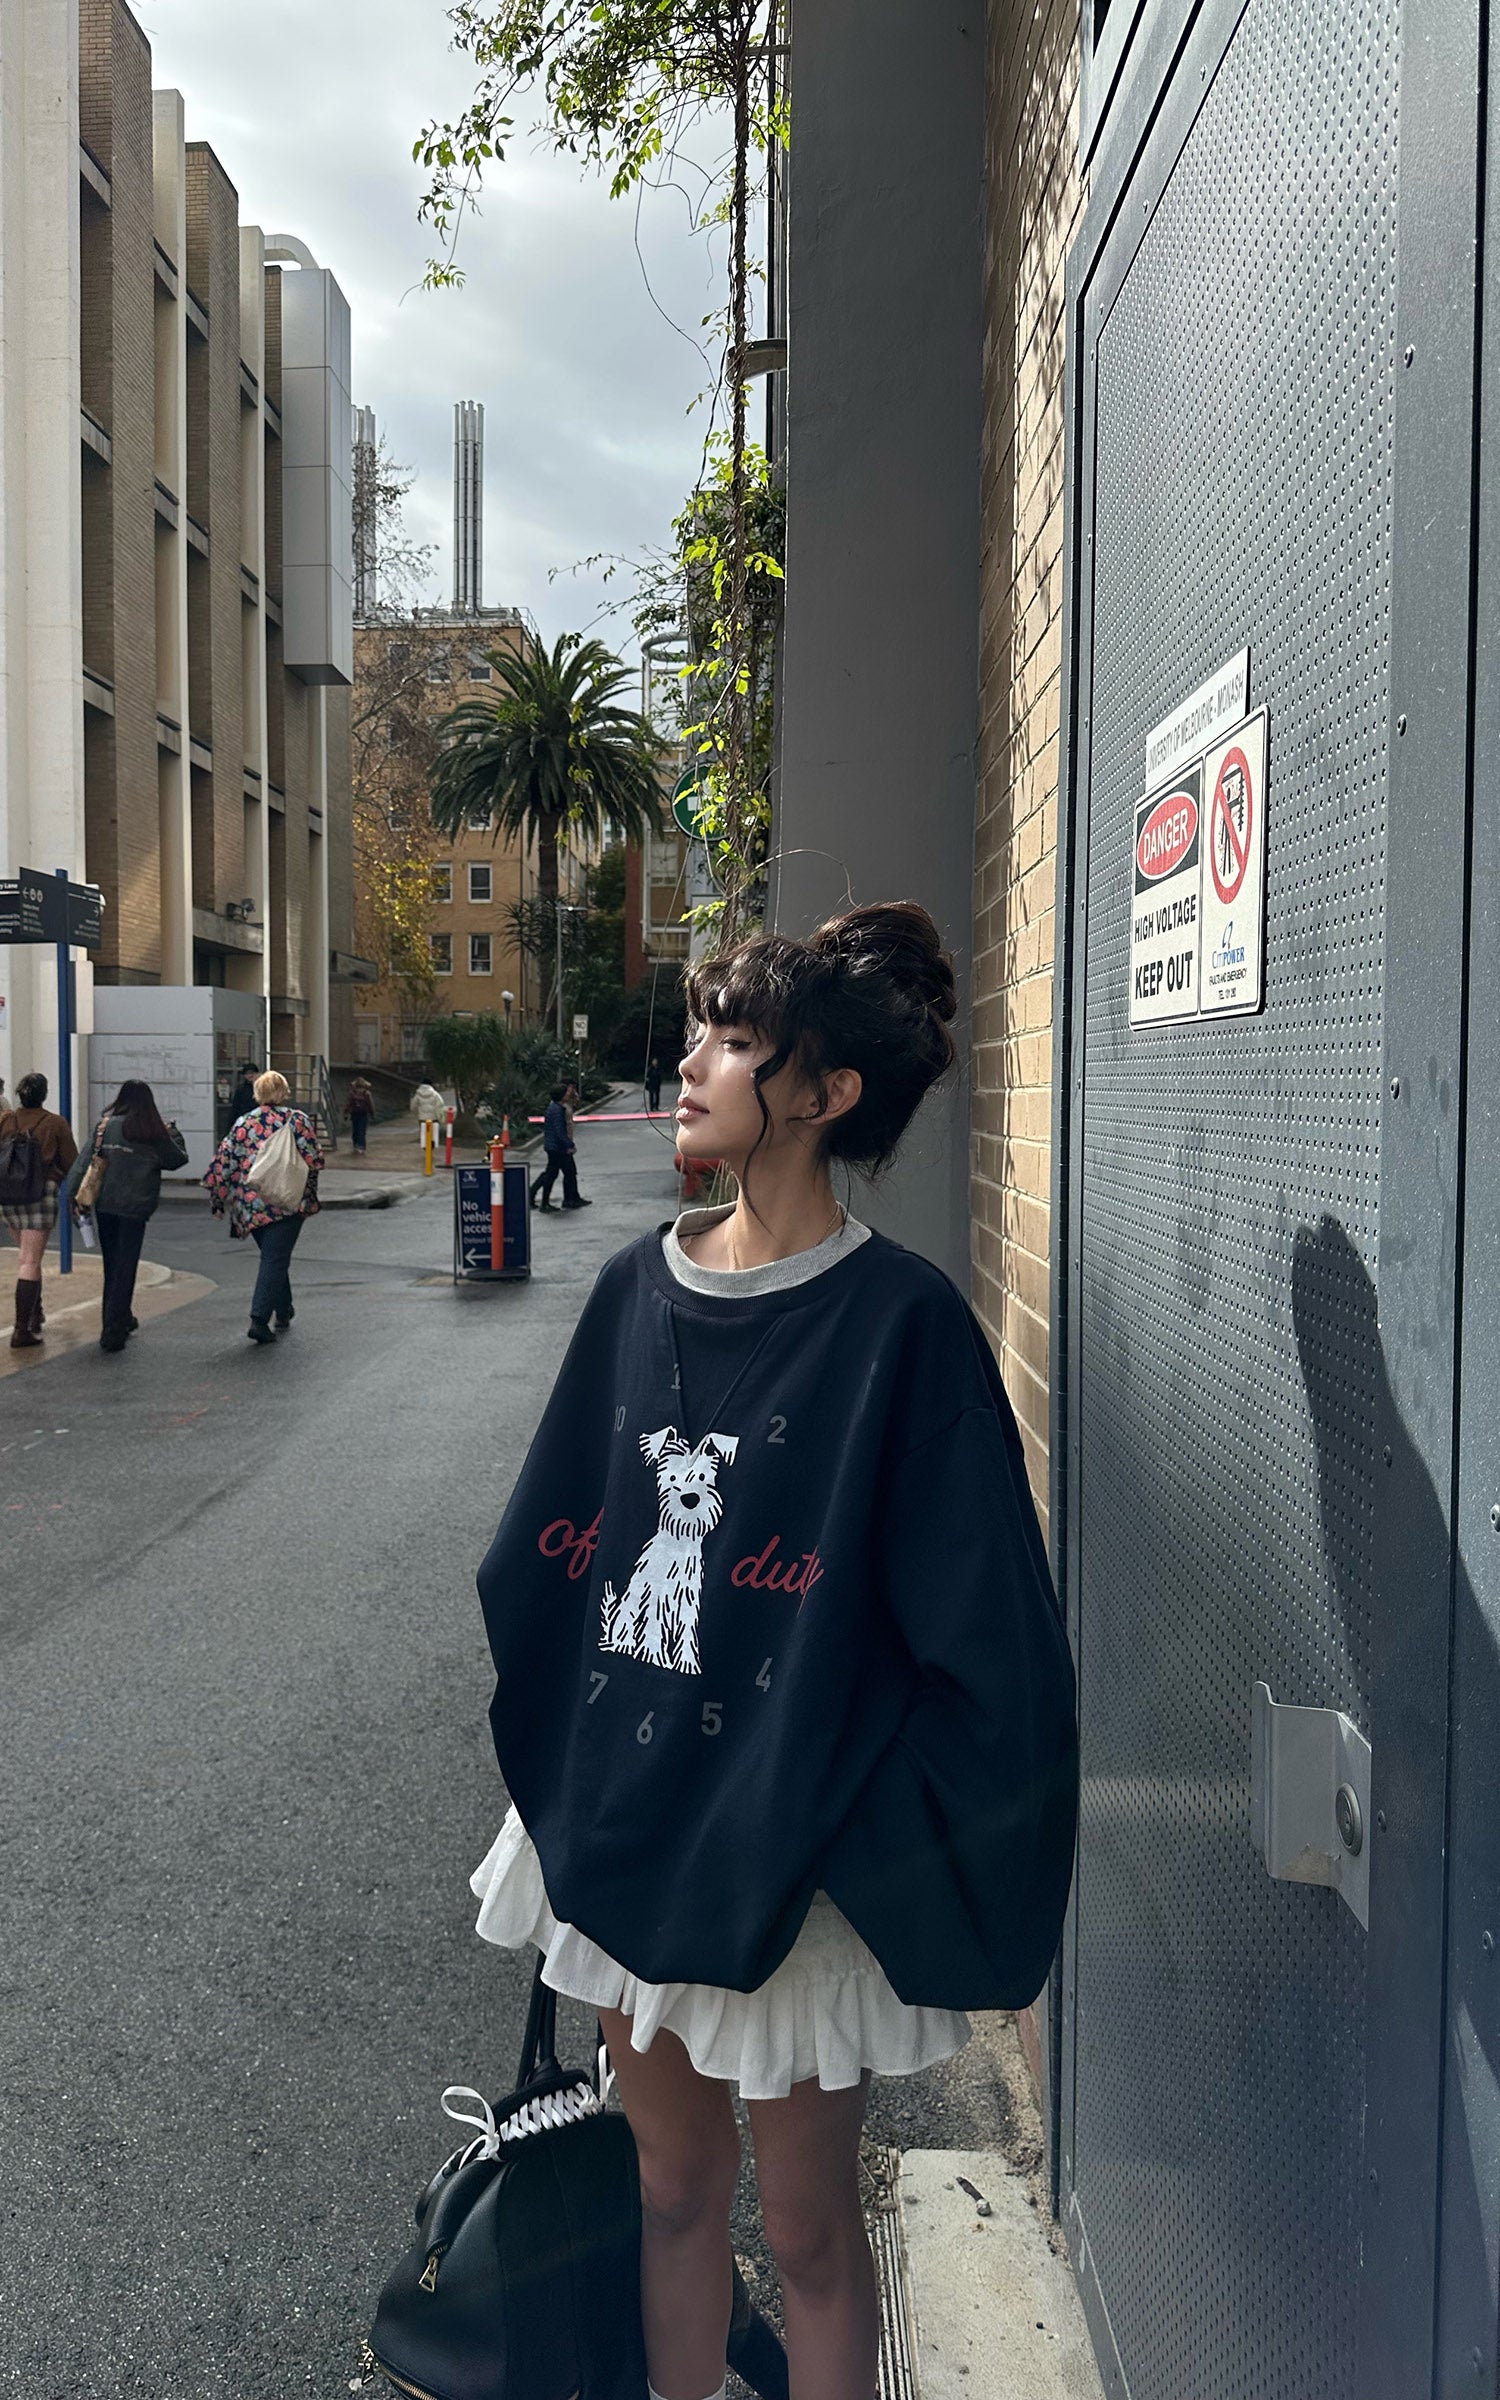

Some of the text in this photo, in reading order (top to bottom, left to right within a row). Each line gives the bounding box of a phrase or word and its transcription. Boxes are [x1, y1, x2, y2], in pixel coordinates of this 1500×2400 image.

[1143, 807, 1189, 865] DANGER
[1135, 894, 1197, 944] HIGH VOLTAGE
[1135, 950, 1193, 1000] KEEP OUT
[462, 1200, 478, 1211] No
[462, 1211, 492, 1222] vehic
[463, 1225, 492, 1234] acces
[767, 1415, 788, 1444] 2
[538, 1505, 605, 1580] of
[586, 1670, 609, 1705] 7
[755, 1657, 773, 1692] 4
[636, 1710, 655, 1745] 6
[700, 1701, 723, 1736] 5
